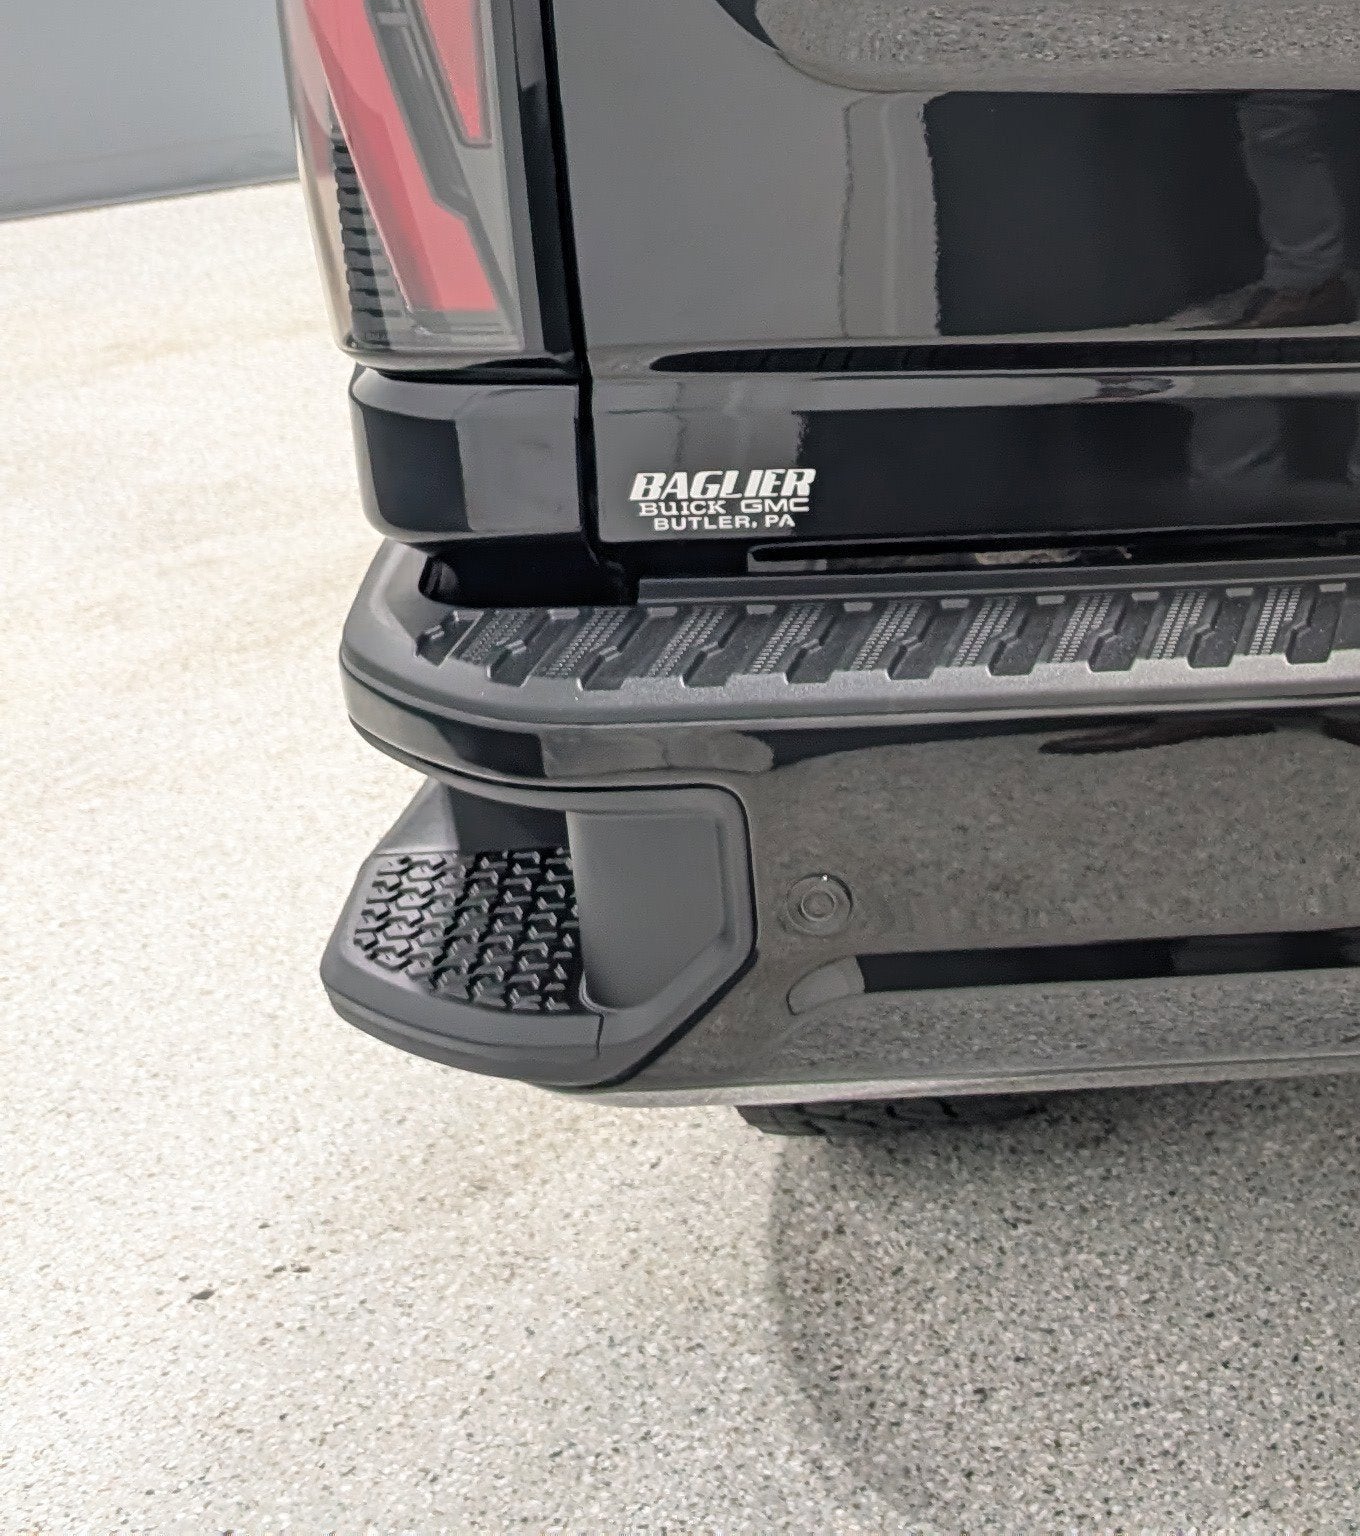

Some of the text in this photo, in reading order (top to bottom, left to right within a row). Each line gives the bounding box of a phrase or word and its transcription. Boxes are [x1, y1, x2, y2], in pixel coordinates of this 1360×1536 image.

[628, 468, 817, 501] BAGLIER
[638, 497, 810, 517] BUICK GMC
[653, 514, 796, 532] BUTLER, PA
